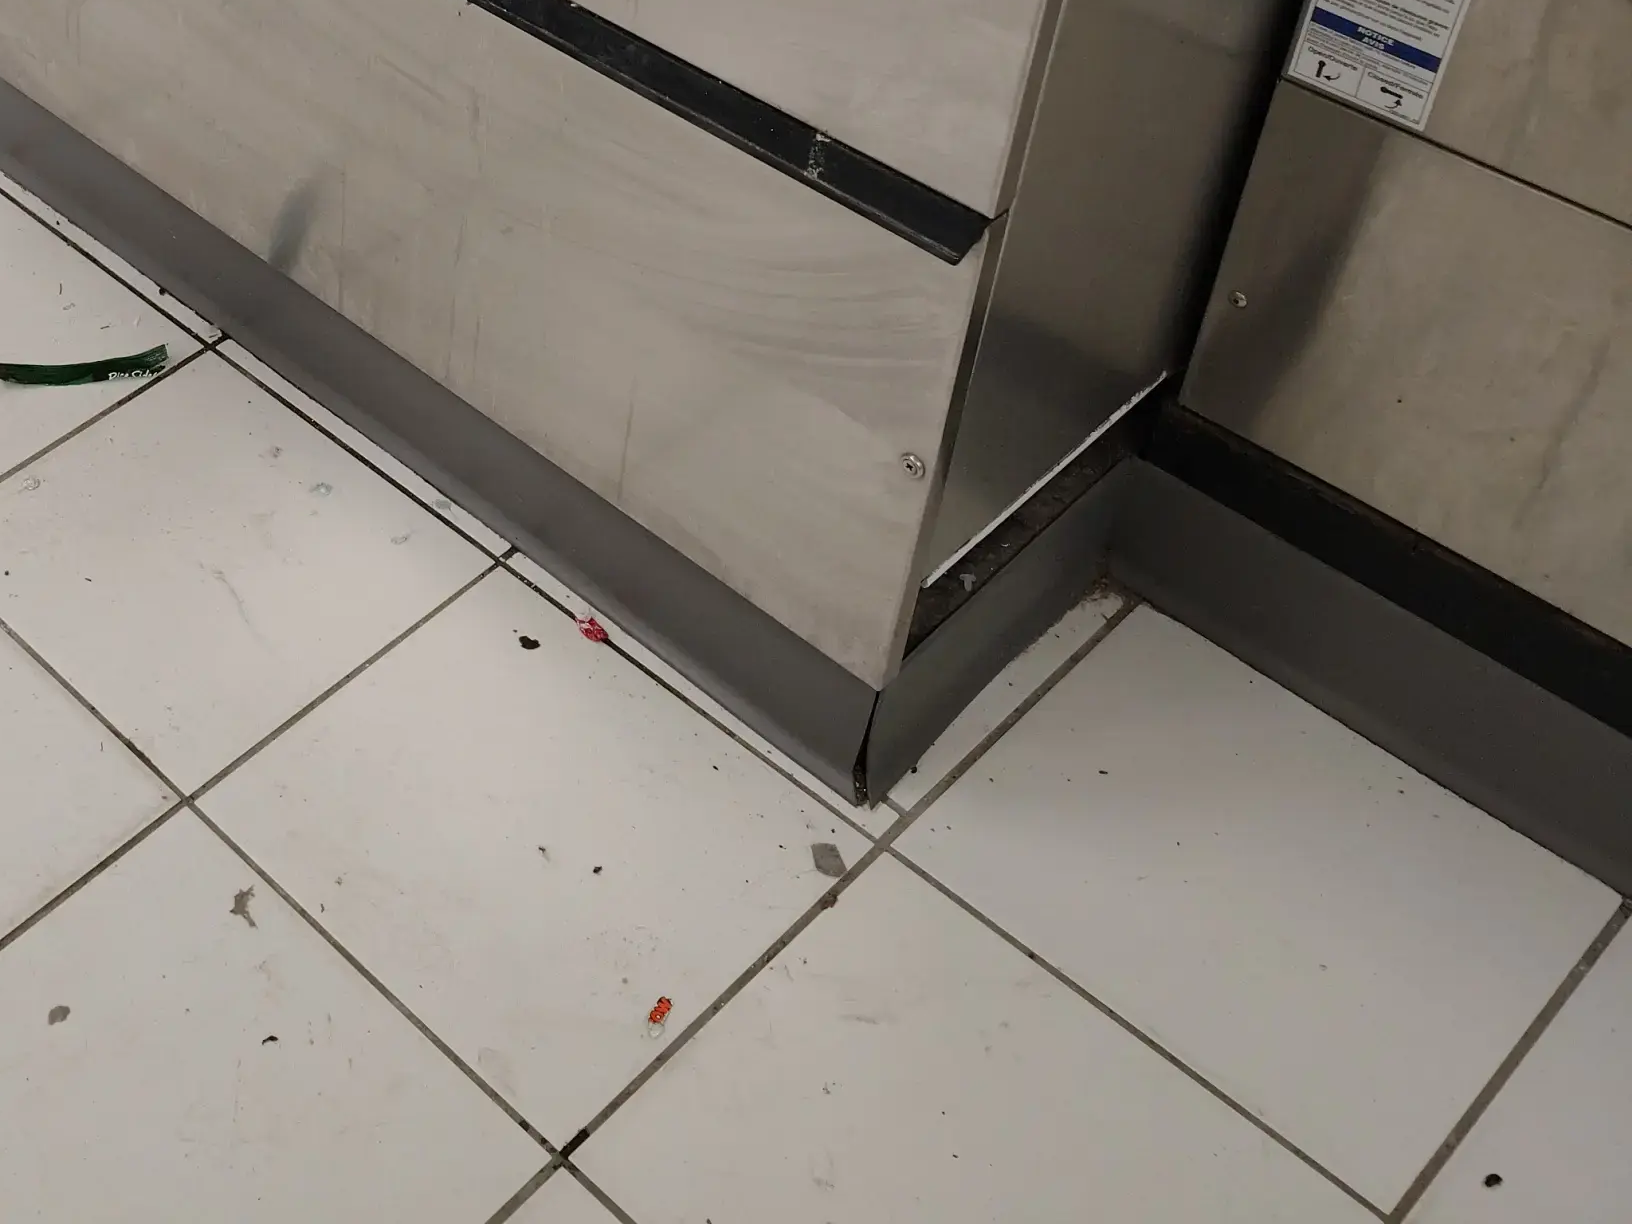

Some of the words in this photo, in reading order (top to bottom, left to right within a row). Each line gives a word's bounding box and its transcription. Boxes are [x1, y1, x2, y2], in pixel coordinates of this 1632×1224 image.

[1356, 26, 1395, 46] NOTICE
[1361, 35, 1385, 50] AVIS
[1307, 46, 1359, 71] Open/Ouverte
